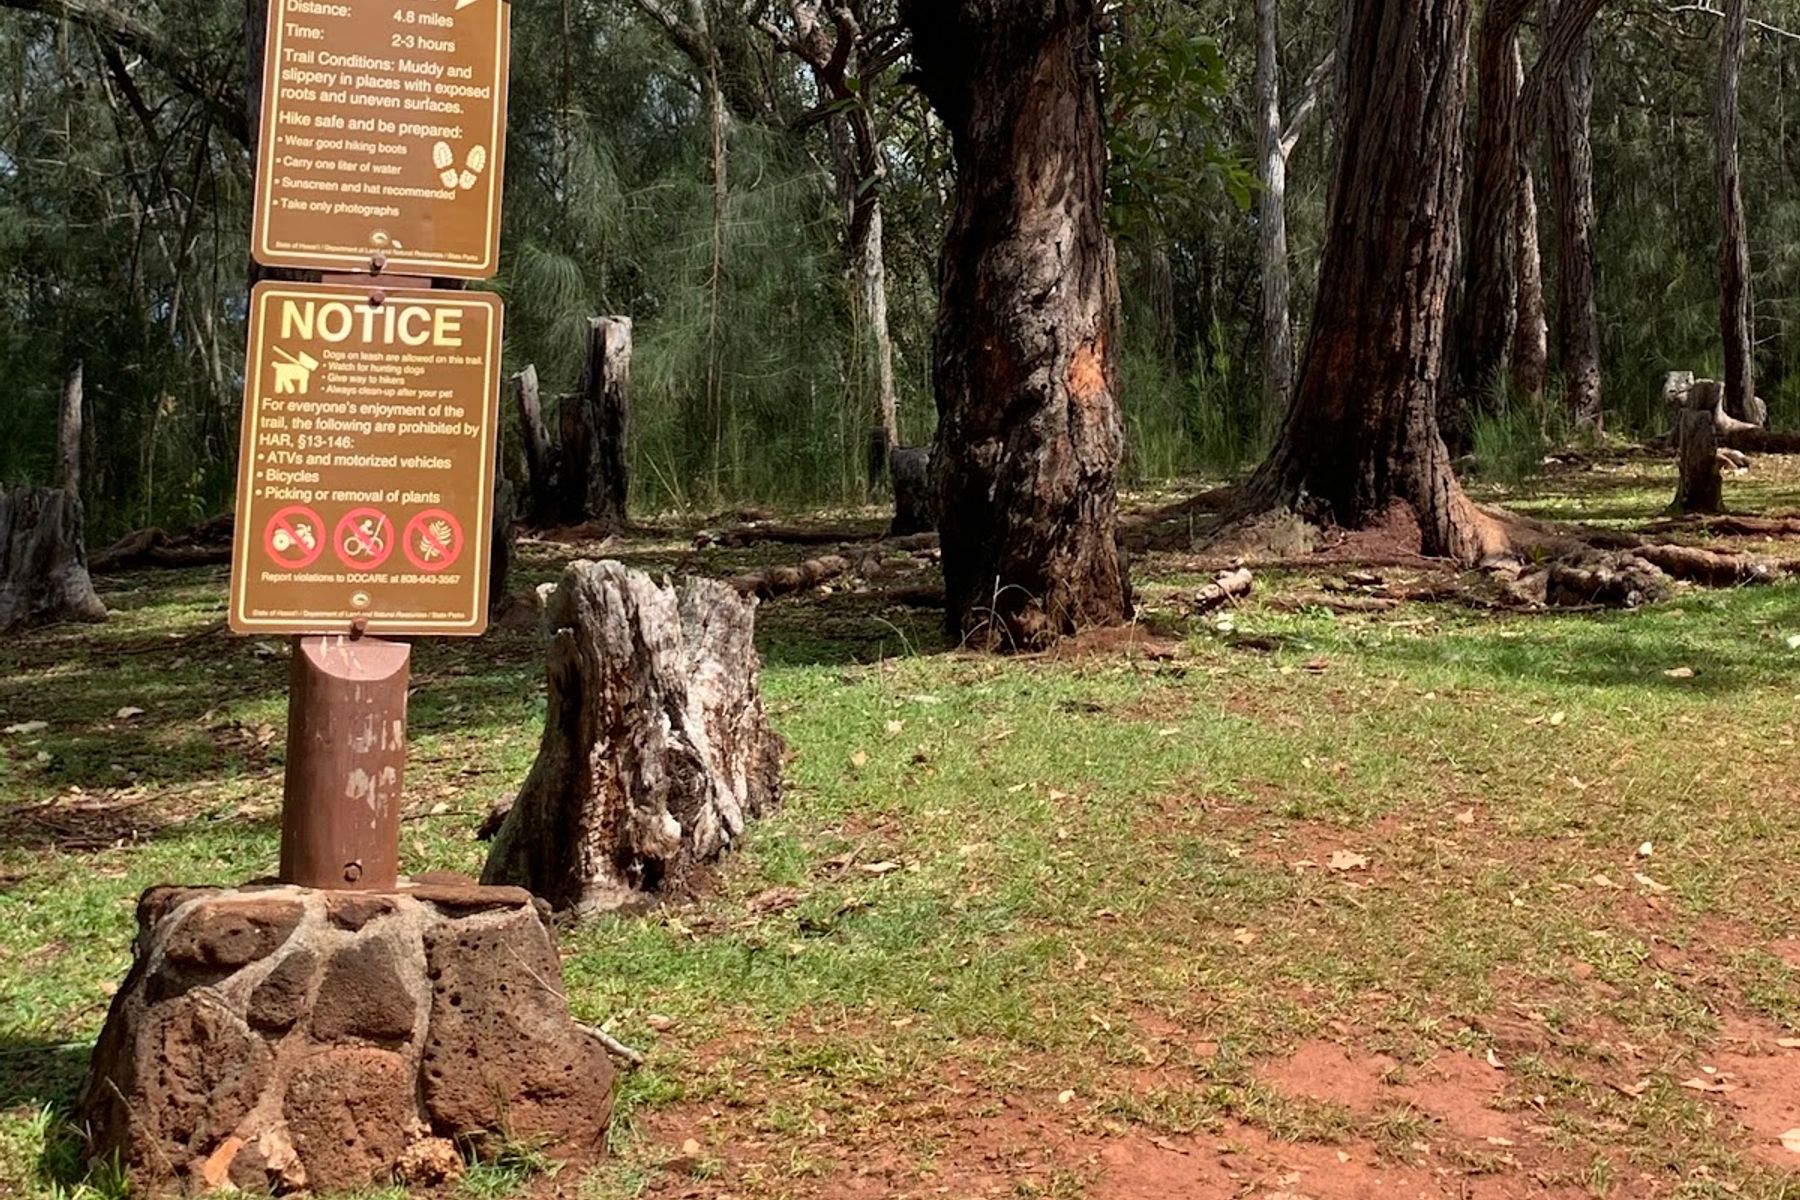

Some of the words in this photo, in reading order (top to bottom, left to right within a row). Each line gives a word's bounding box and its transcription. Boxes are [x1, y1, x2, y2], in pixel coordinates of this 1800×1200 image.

[393, 9, 415, 23] 4.8
[419, 12, 454, 28] miles
[285, 22, 324, 40] Time:
[392, 33, 414, 48] 2-3
[418, 36, 455, 52] hours
[283, 48, 314, 64] Trail
[318, 51, 394, 71] Conditions:
[398, 59, 444, 78] Muddy
[447, 66, 472, 78] and
[282, 67, 336, 87] slippery
[340, 72, 352, 85] in
[356, 74, 400, 90] places
[404, 78, 431, 92] with
[435, 83, 490, 99] exposed
[281, 88, 316, 101] roots
[320, 90, 346, 103] and
[350, 94, 400, 108] uneven
[404, 96, 464, 114] surfaces.
[280, 110, 311, 126] Hike
[314, 115, 344, 128] safe
[348, 119, 374, 131] and
[378, 119, 395, 132] be
[399, 123, 463, 139] prepared:
[285, 134, 314, 146] Wear
[316, 140, 343, 150] good
[345, 140, 376, 154] hiking
[378, 142, 407, 154] boots
[283, 156, 312, 170] Carry
[315, 160, 335, 170] one
[338, 159, 357, 171] liter
[360, 162, 370, 172] of
[372, 164, 401, 174] water
[282, 177, 338, 191] Sunscreen
[341, 183, 361, 192] and
[363, 183, 380, 194] hat
[383, 186, 455, 200] recommended
[280, 197, 307, 210] Take
[310, 201, 332, 214] only
[334, 202, 399, 217] photographs
[281, 300, 462, 346] NOTICE
[323, 350, 346, 361] Dogs
[347, 352, 359, 360] on
[360, 352, 383, 360] leash
[386, 354, 400, 362] are
[401, 353, 434, 363] allowed
[436, 356, 447, 364] on
[449, 356, 464, 364] this
[465, 356, 483, 365] trail.
[327, 372, 347, 382] Give
[350, 376, 367, 385] way
[379, 376, 404, 385] hikers
[328, 361, 355, 371] Watch
[357, 363, 369, 371] for
[370, 364, 402, 375] hunting
[404, 366, 425, 376] dogs
[326, 384, 356, 396] Always
[358, 386, 395, 397] clean-up
[397, 388, 416, 397] after
[418, 390, 437, 399] your
[439, 390, 453, 399] pet
[262, 398, 284, 410] For
[287, 401, 356, 415] everyone's
[360, 402, 426, 418] enjoyment
[428, 405, 442, 416] of
[444, 405, 464, 417] the
[261, 416, 288, 430] trail,
[292, 417, 312, 430] the
[316, 417, 371, 435] following
[375, 422, 396, 433] are
[399, 421, 461, 436] prohibited
[464, 422, 479, 438] by
[260, 433, 294, 448] HAR,
[298, 434, 354, 449] §13-146:
[267, 451, 303, 464] ATVs
[306, 453, 331, 466] and
[334, 454, 397, 467] motorized
[401, 456, 452, 469] vehicles
[266, 468, 320, 484] Bicycles
[264, 486, 311, 504] Picking
[315, 490, 329, 500] or
[332, 490, 383, 502] removal
[386, 490, 399, 502] of
[402, 491, 440, 506] plants
[261, 572, 292, 583] Report
[294, 572, 334, 582] violations
[336, 574, 344, 582] to
[347, 574, 388, 583] DOCARE
[390, 574, 399, 583] at
